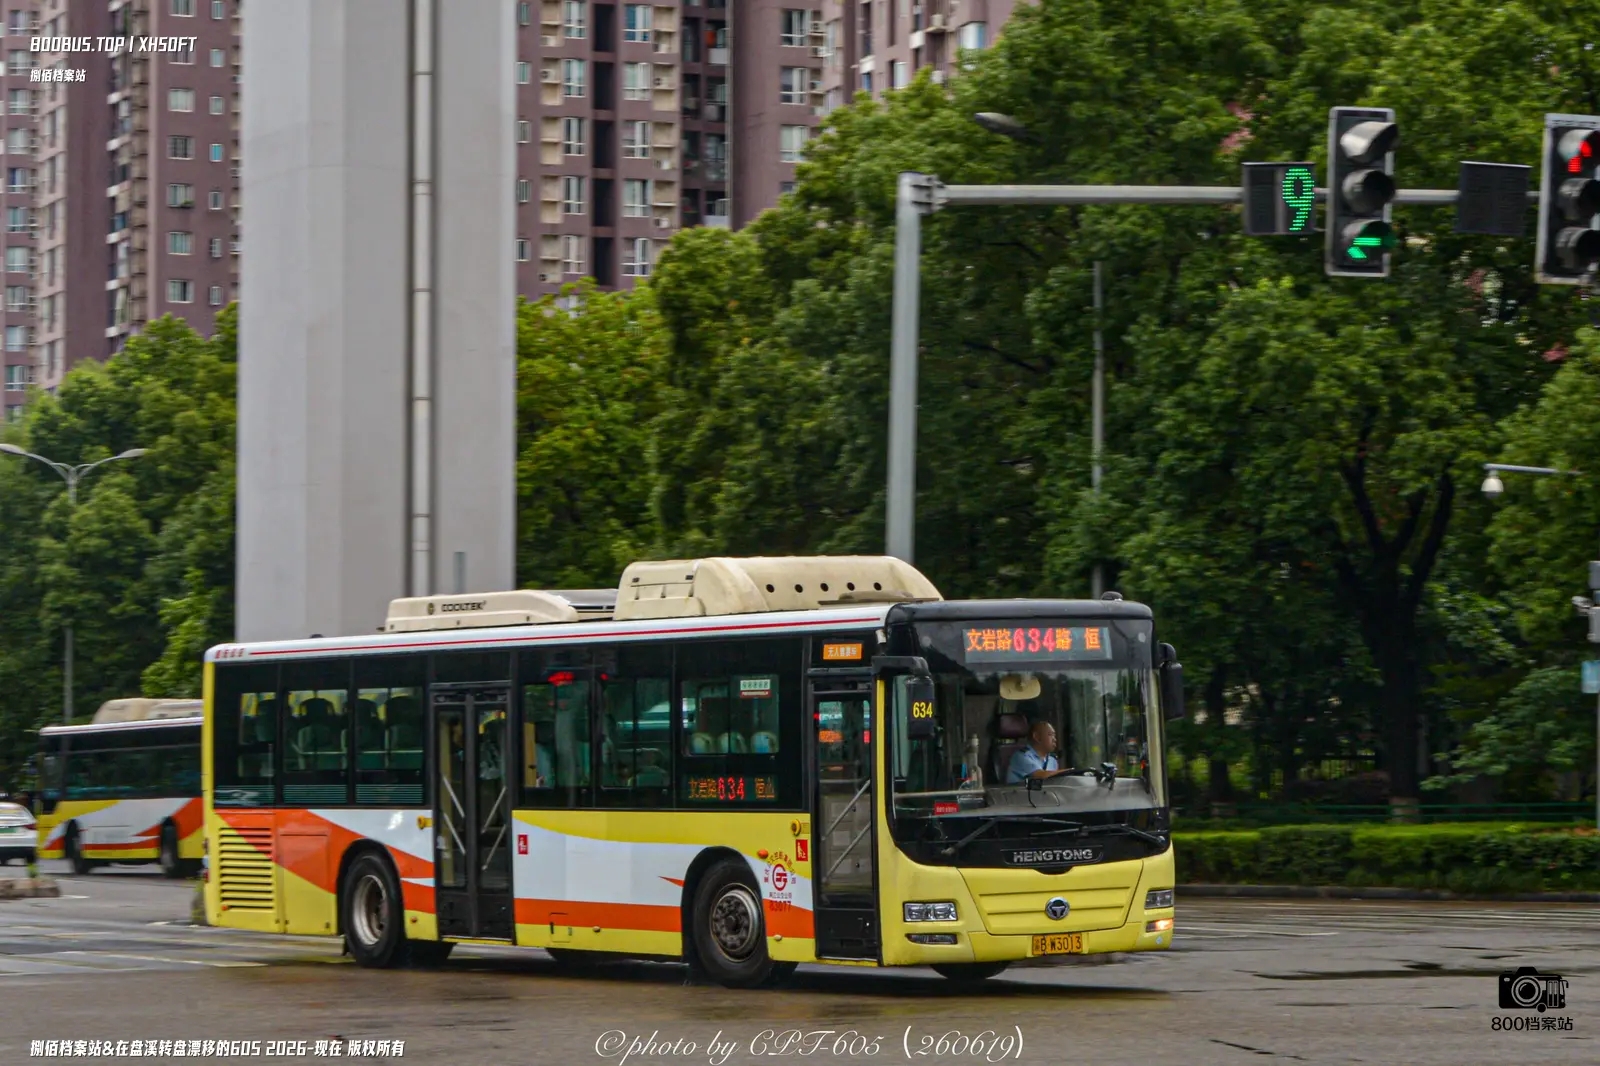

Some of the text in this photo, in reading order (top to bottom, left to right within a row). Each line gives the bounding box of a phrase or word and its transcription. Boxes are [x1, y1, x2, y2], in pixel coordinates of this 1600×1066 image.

[1282, 168, 1315, 231] 9
[441, 602, 484, 612] COOLTEK
[912, 702, 933, 718] 634
[1013, 849, 1093, 862] HENGTONG
